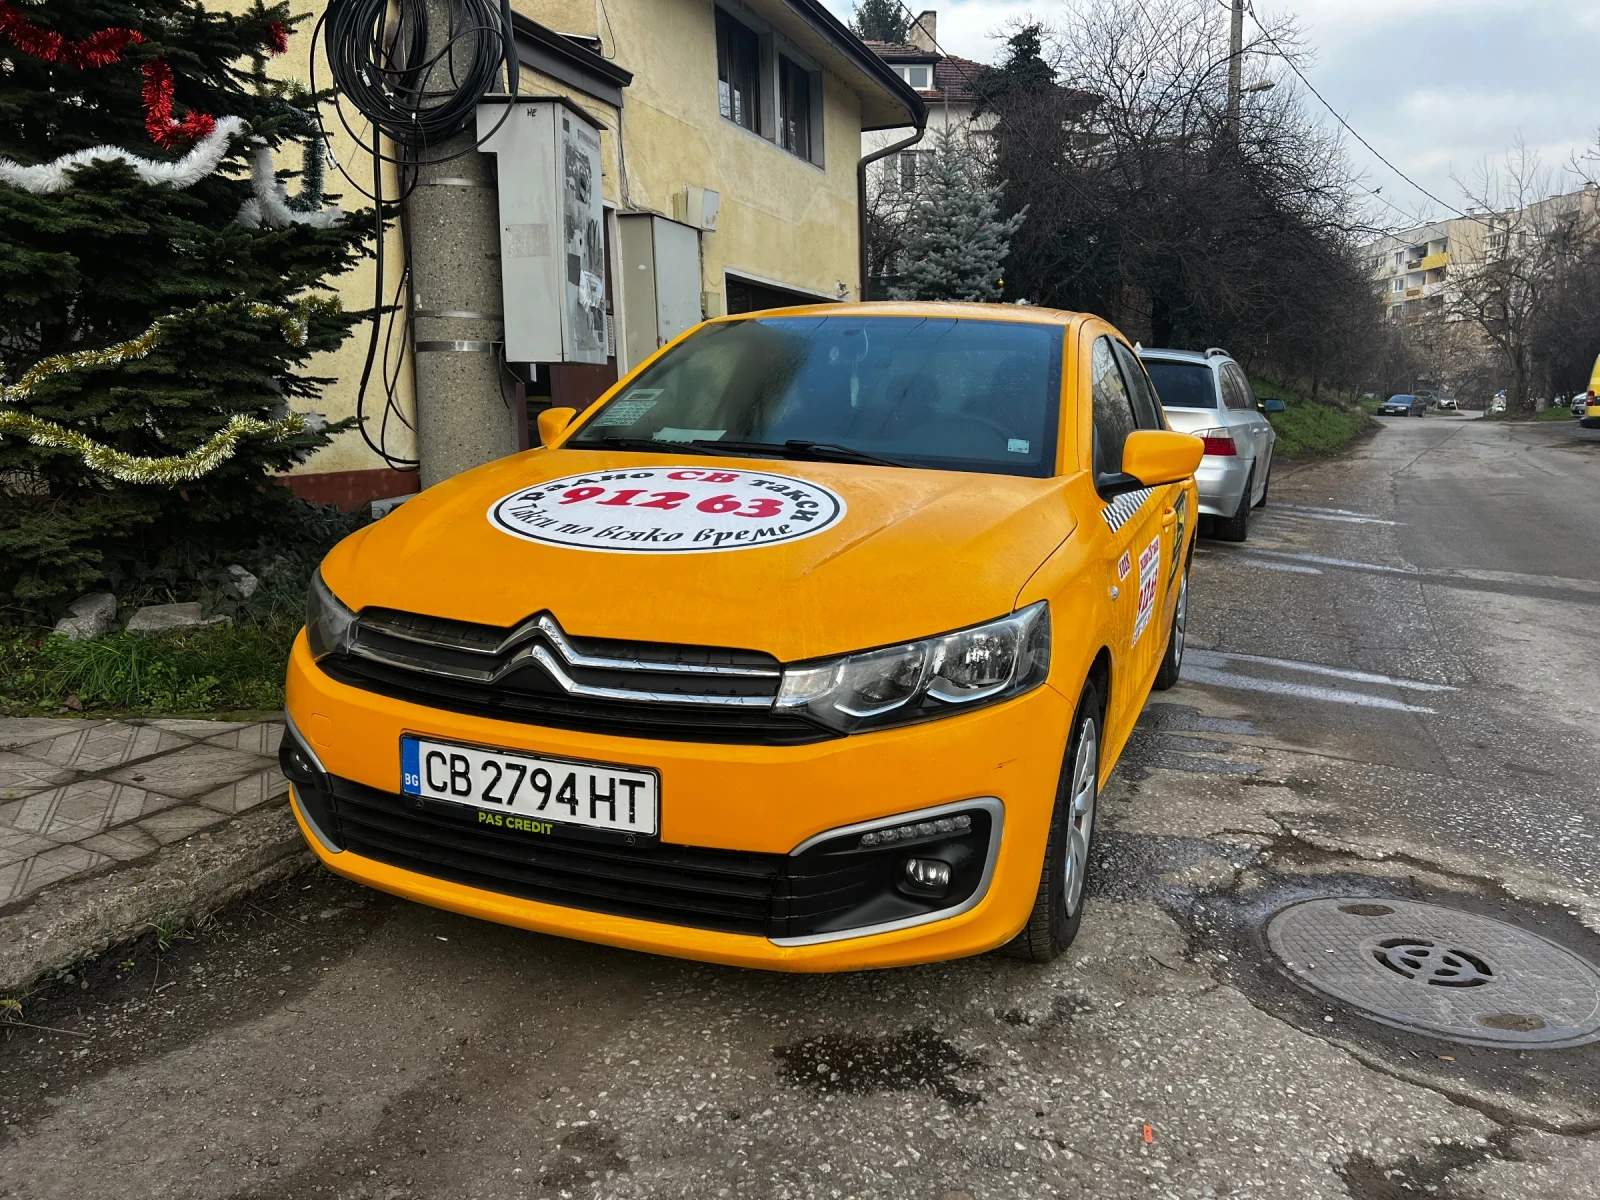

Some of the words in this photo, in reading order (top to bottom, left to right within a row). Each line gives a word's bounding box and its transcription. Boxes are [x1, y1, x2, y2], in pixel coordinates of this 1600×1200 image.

[696, 494, 784, 518] 63
[404, 773, 419, 787] BG
[425, 750, 472, 797] CB
[480, 759, 579, 816] 2794
[589, 774, 646, 824] HT
[478, 811, 503, 827] PAS
[505, 817, 553, 835] CREDIT
